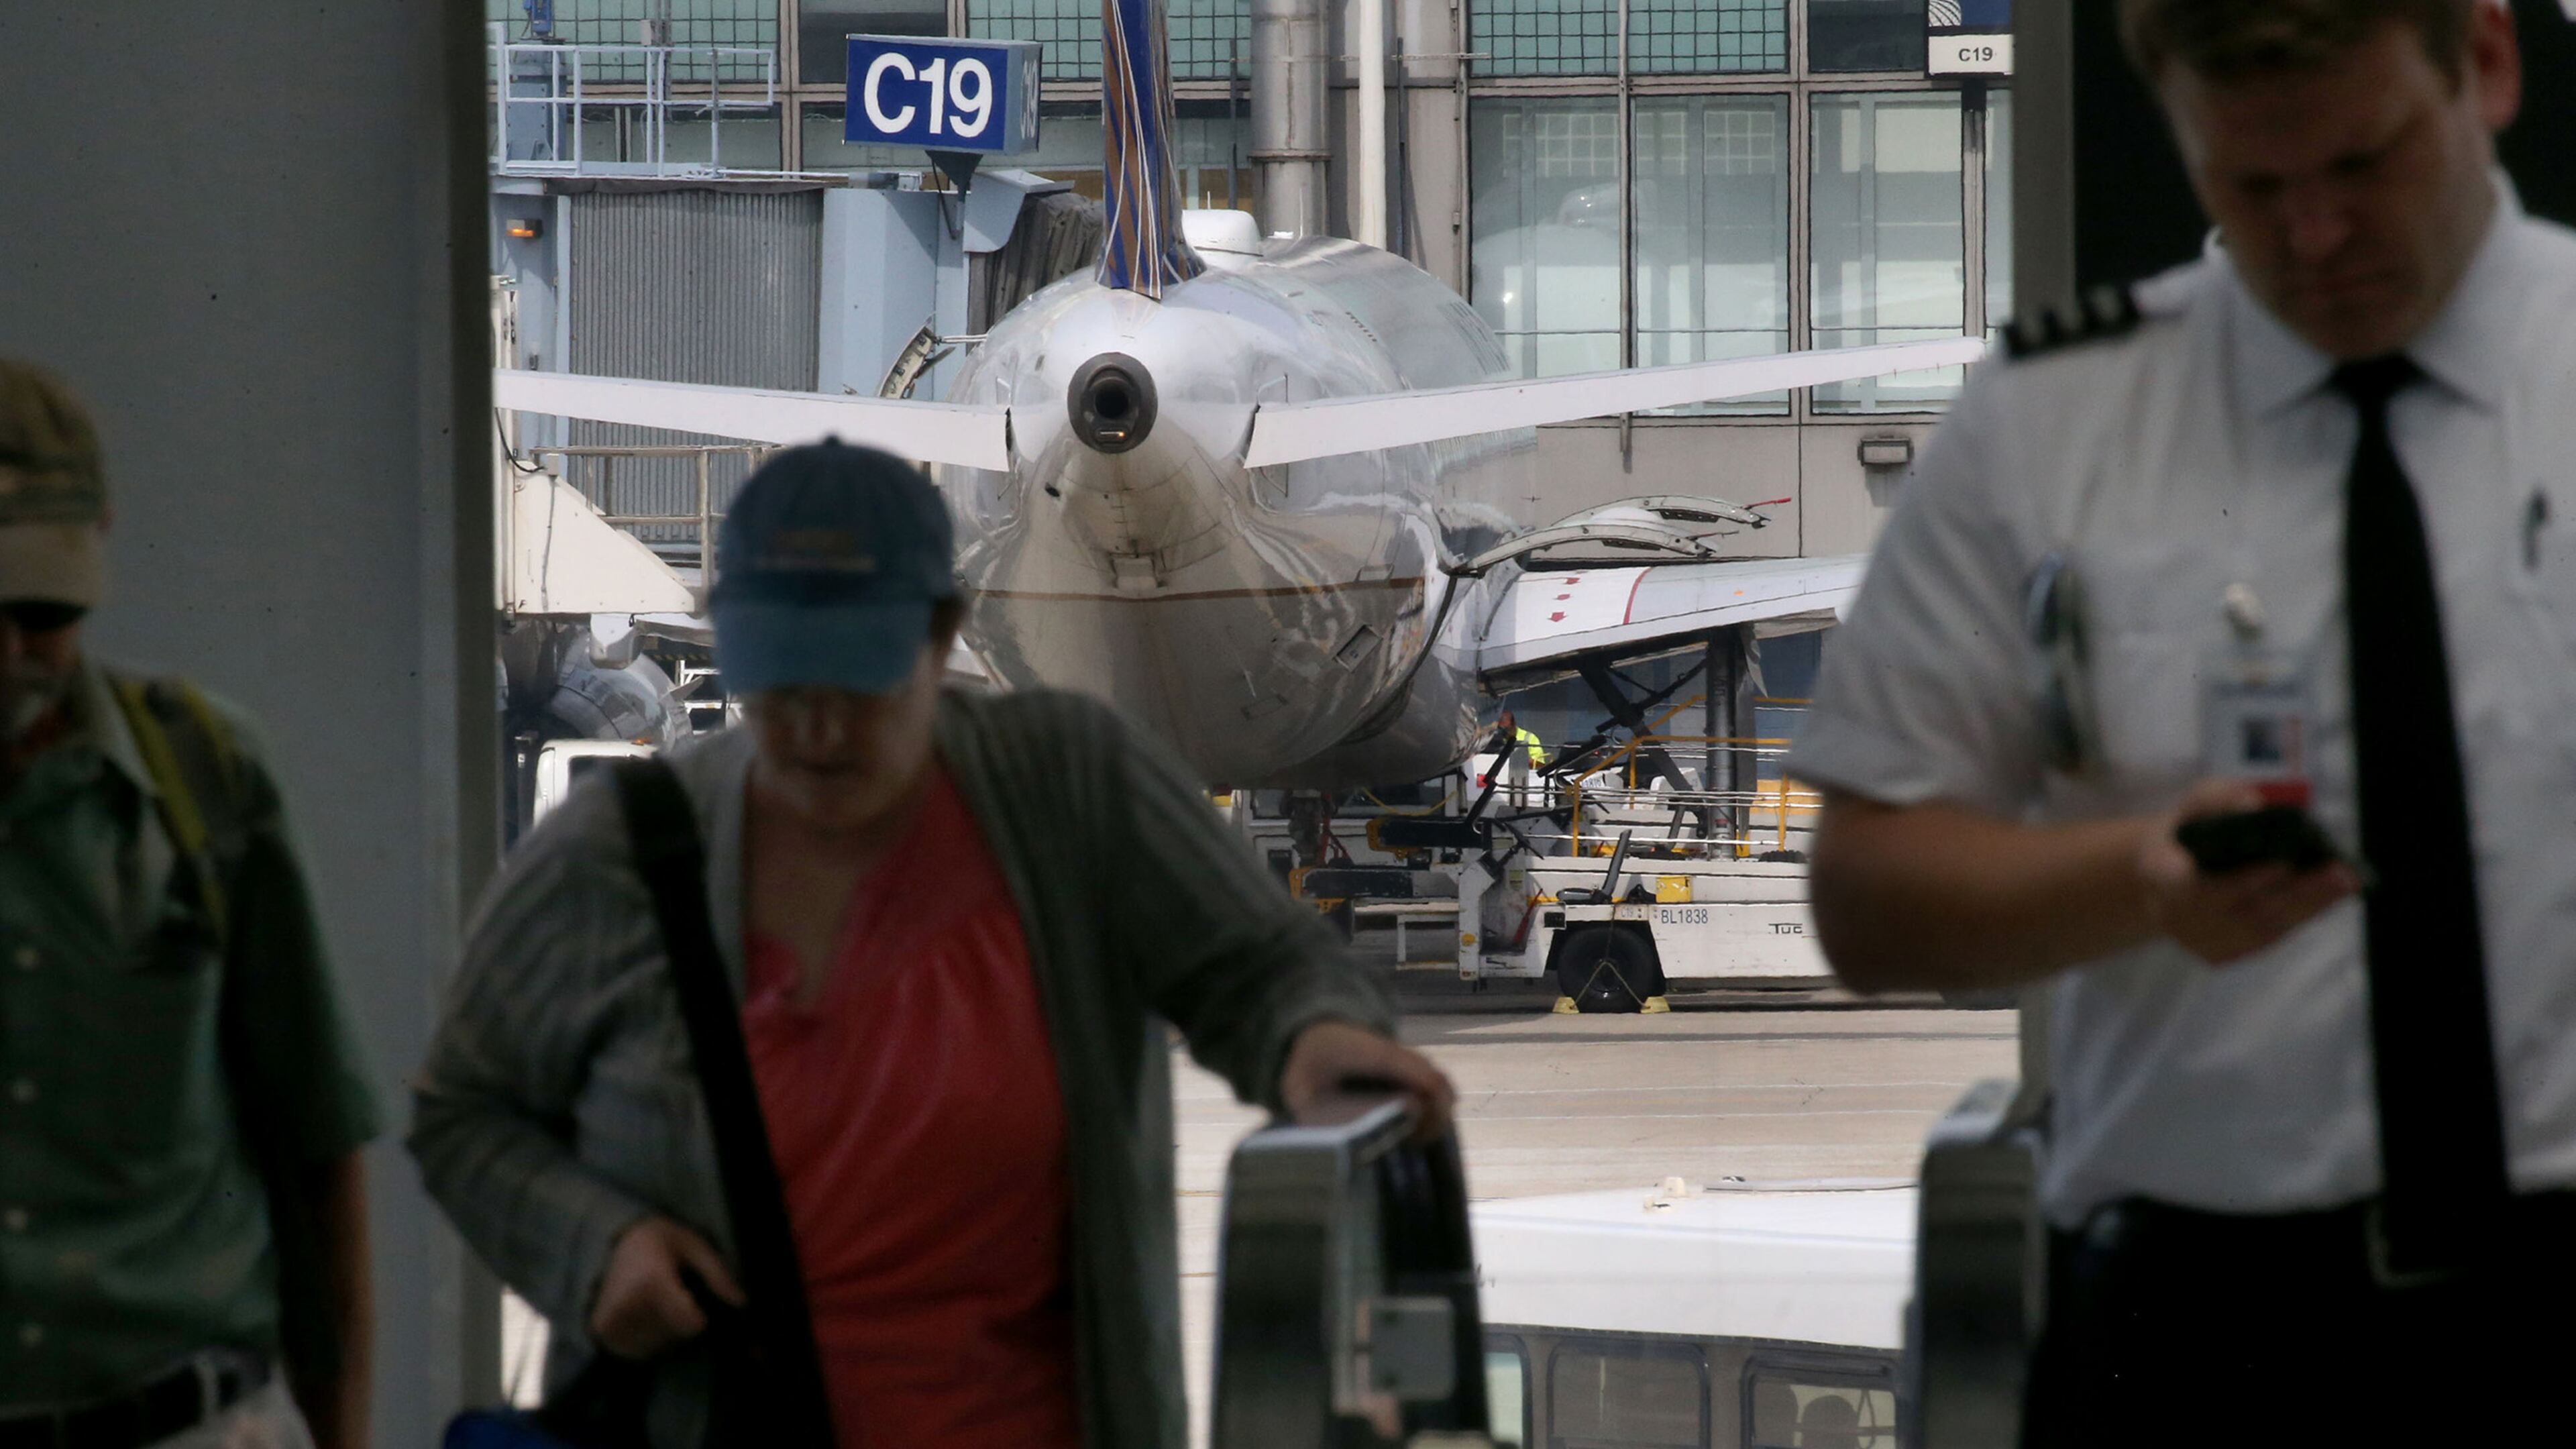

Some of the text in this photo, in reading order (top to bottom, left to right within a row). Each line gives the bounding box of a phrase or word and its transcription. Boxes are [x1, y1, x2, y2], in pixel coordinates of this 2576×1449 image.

[1958, 46, 1993, 62] C19
[864, 52, 993, 138] C19
[1661, 908, 1709, 924] BL1838
